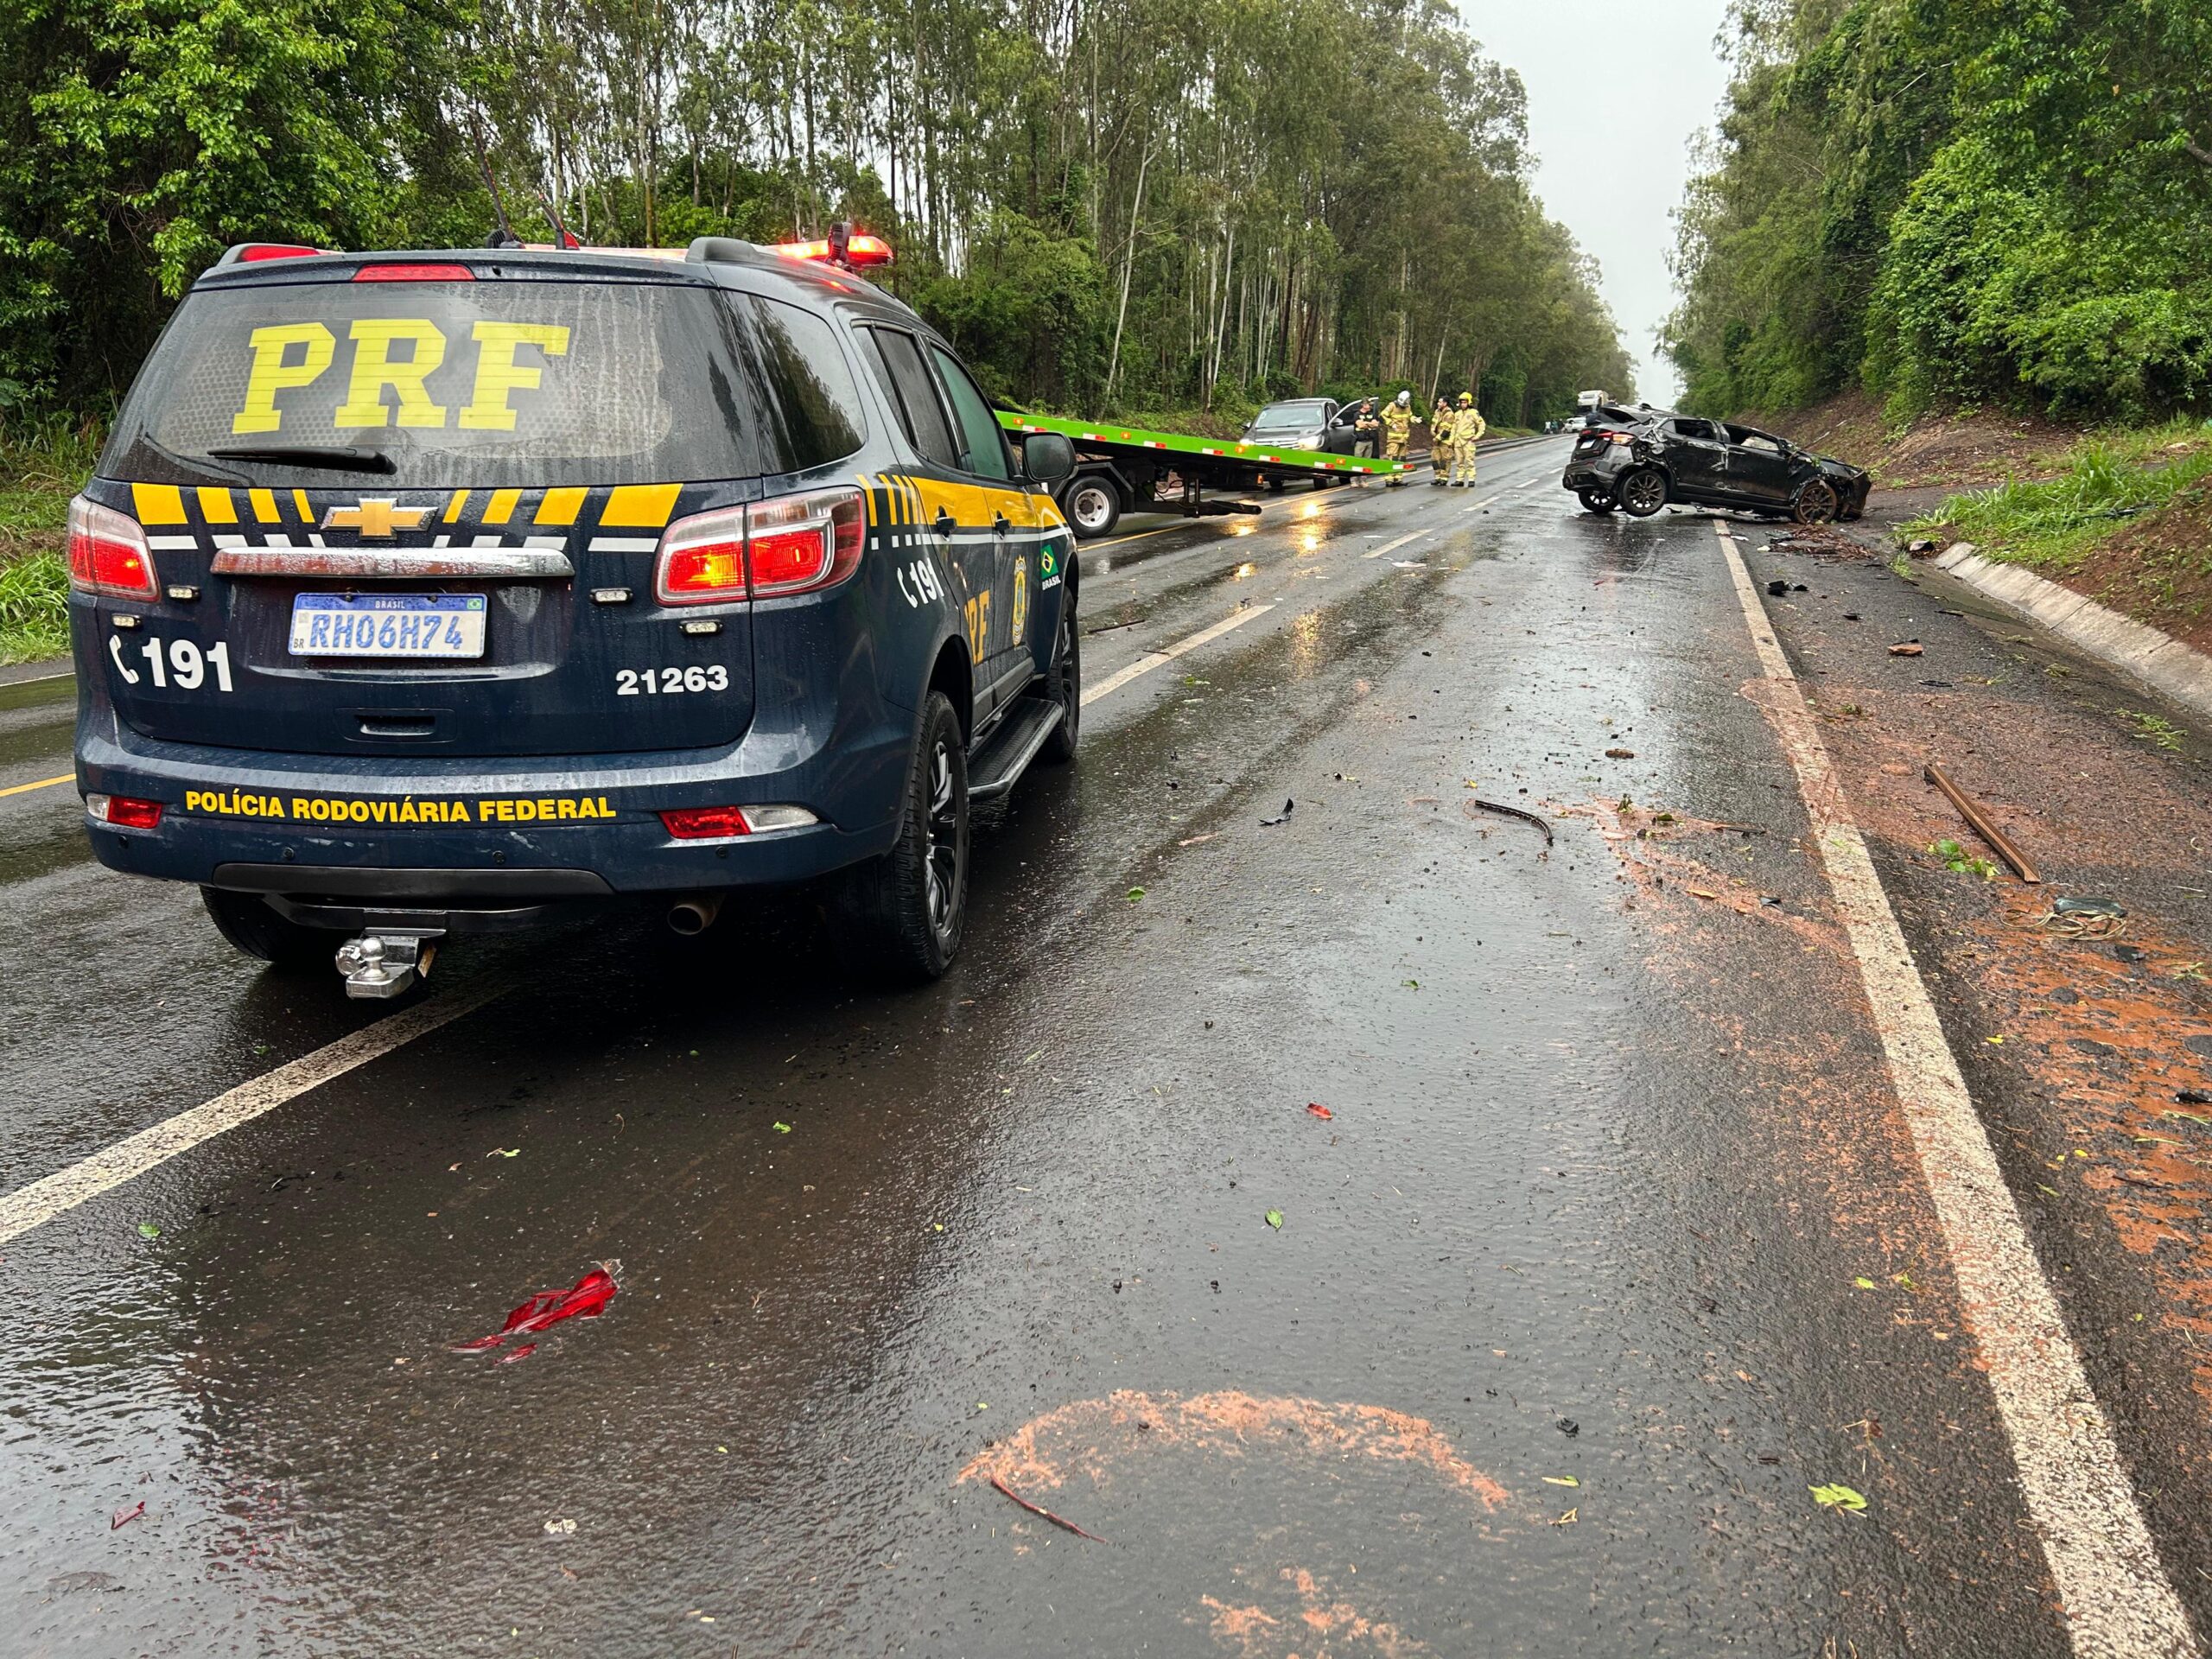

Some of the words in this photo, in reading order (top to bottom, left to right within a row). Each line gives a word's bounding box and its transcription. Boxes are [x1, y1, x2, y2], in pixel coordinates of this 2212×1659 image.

[232, 318, 570, 435] PRF
[910, 557, 944, 603] 191
[1042, 575, 1061, 591] BRASIL
[375, 601, 405, 609] BRASIL
[293, 638, 304, 649] BR
[142, 637, 232, 691] 191
[616, 664, 728, 695] 21263
[186, 788, 285, 817] POLÍCIA
[292, 796, 471, 823] RODOVIÁRIA
[479, 797, 616, 822] FEDERAL
